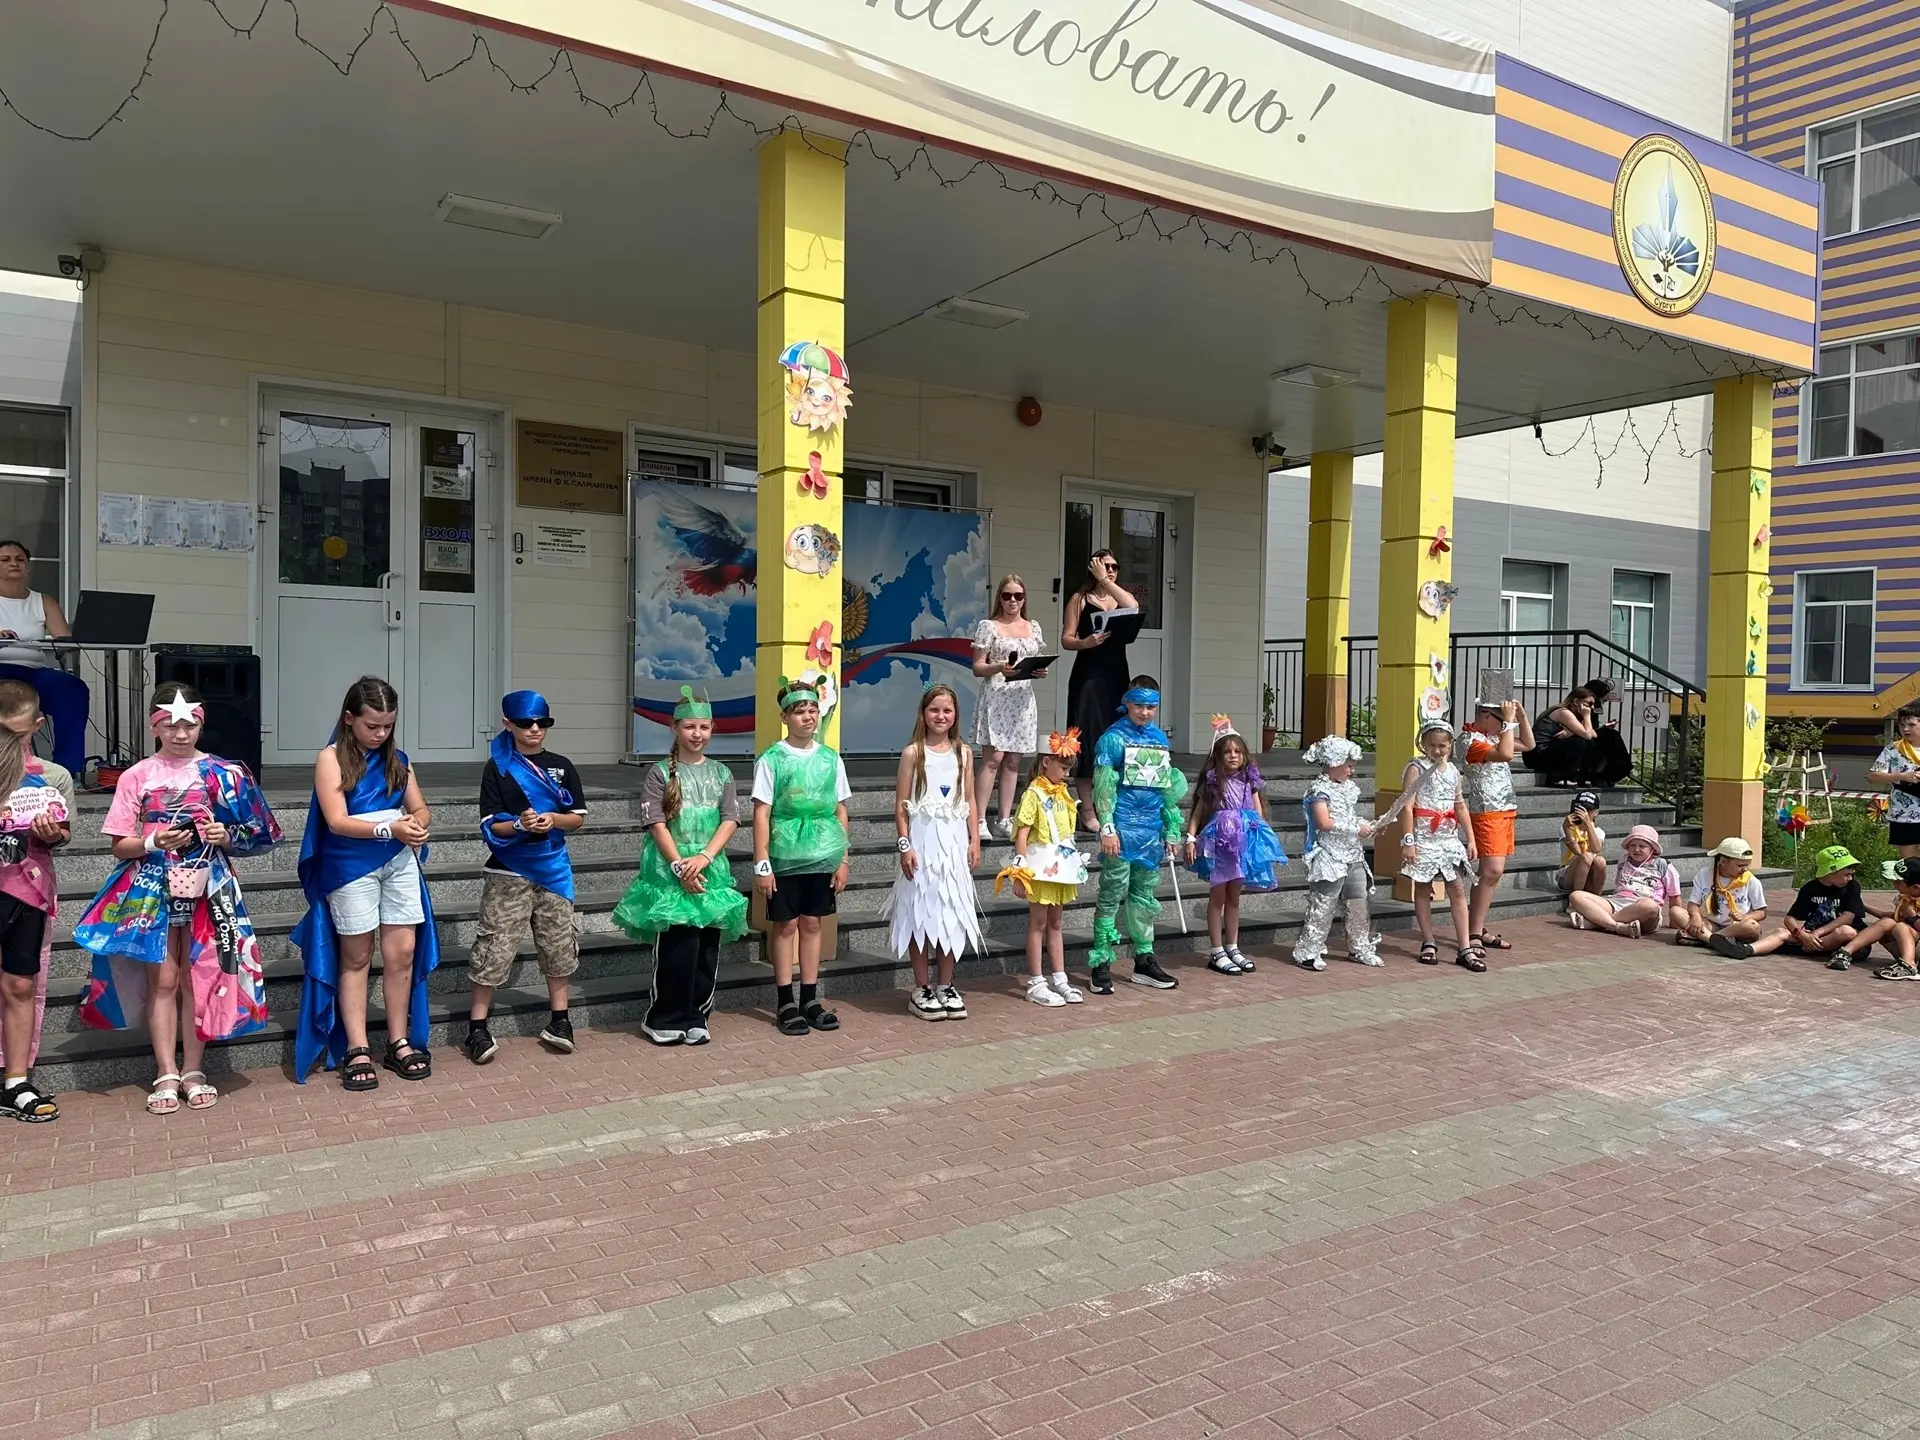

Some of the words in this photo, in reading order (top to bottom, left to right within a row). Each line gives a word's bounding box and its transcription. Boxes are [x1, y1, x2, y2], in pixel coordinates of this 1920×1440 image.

[1653, 297, 1677, 312] Сургут
[641, 462, 676, 472] ВНИМАНИЕ
[550, 468, 593, 479] ГИМНАЗИЯ
[523, 475, 552, 484] ИМЕНИ
[572, 479, 619, 491] САЛМАНОВА
[424, 526, 472, 543] ВХОД
[438, 545, 459, 554] ВХОД
[10, 792, 40, 801] никулы
[12, 798, 40, 806] время
[14, 802, 45, 813] чудес!
[1104, 824, 1115, 836] 1
[899, 839, 909, 851] 8
[1405, 835, 1413, 843] 6
[760, 861, 770, 873] 4
[1015, 856, 1022, 868] 1
[219, 922, 231, 953] Ozon
